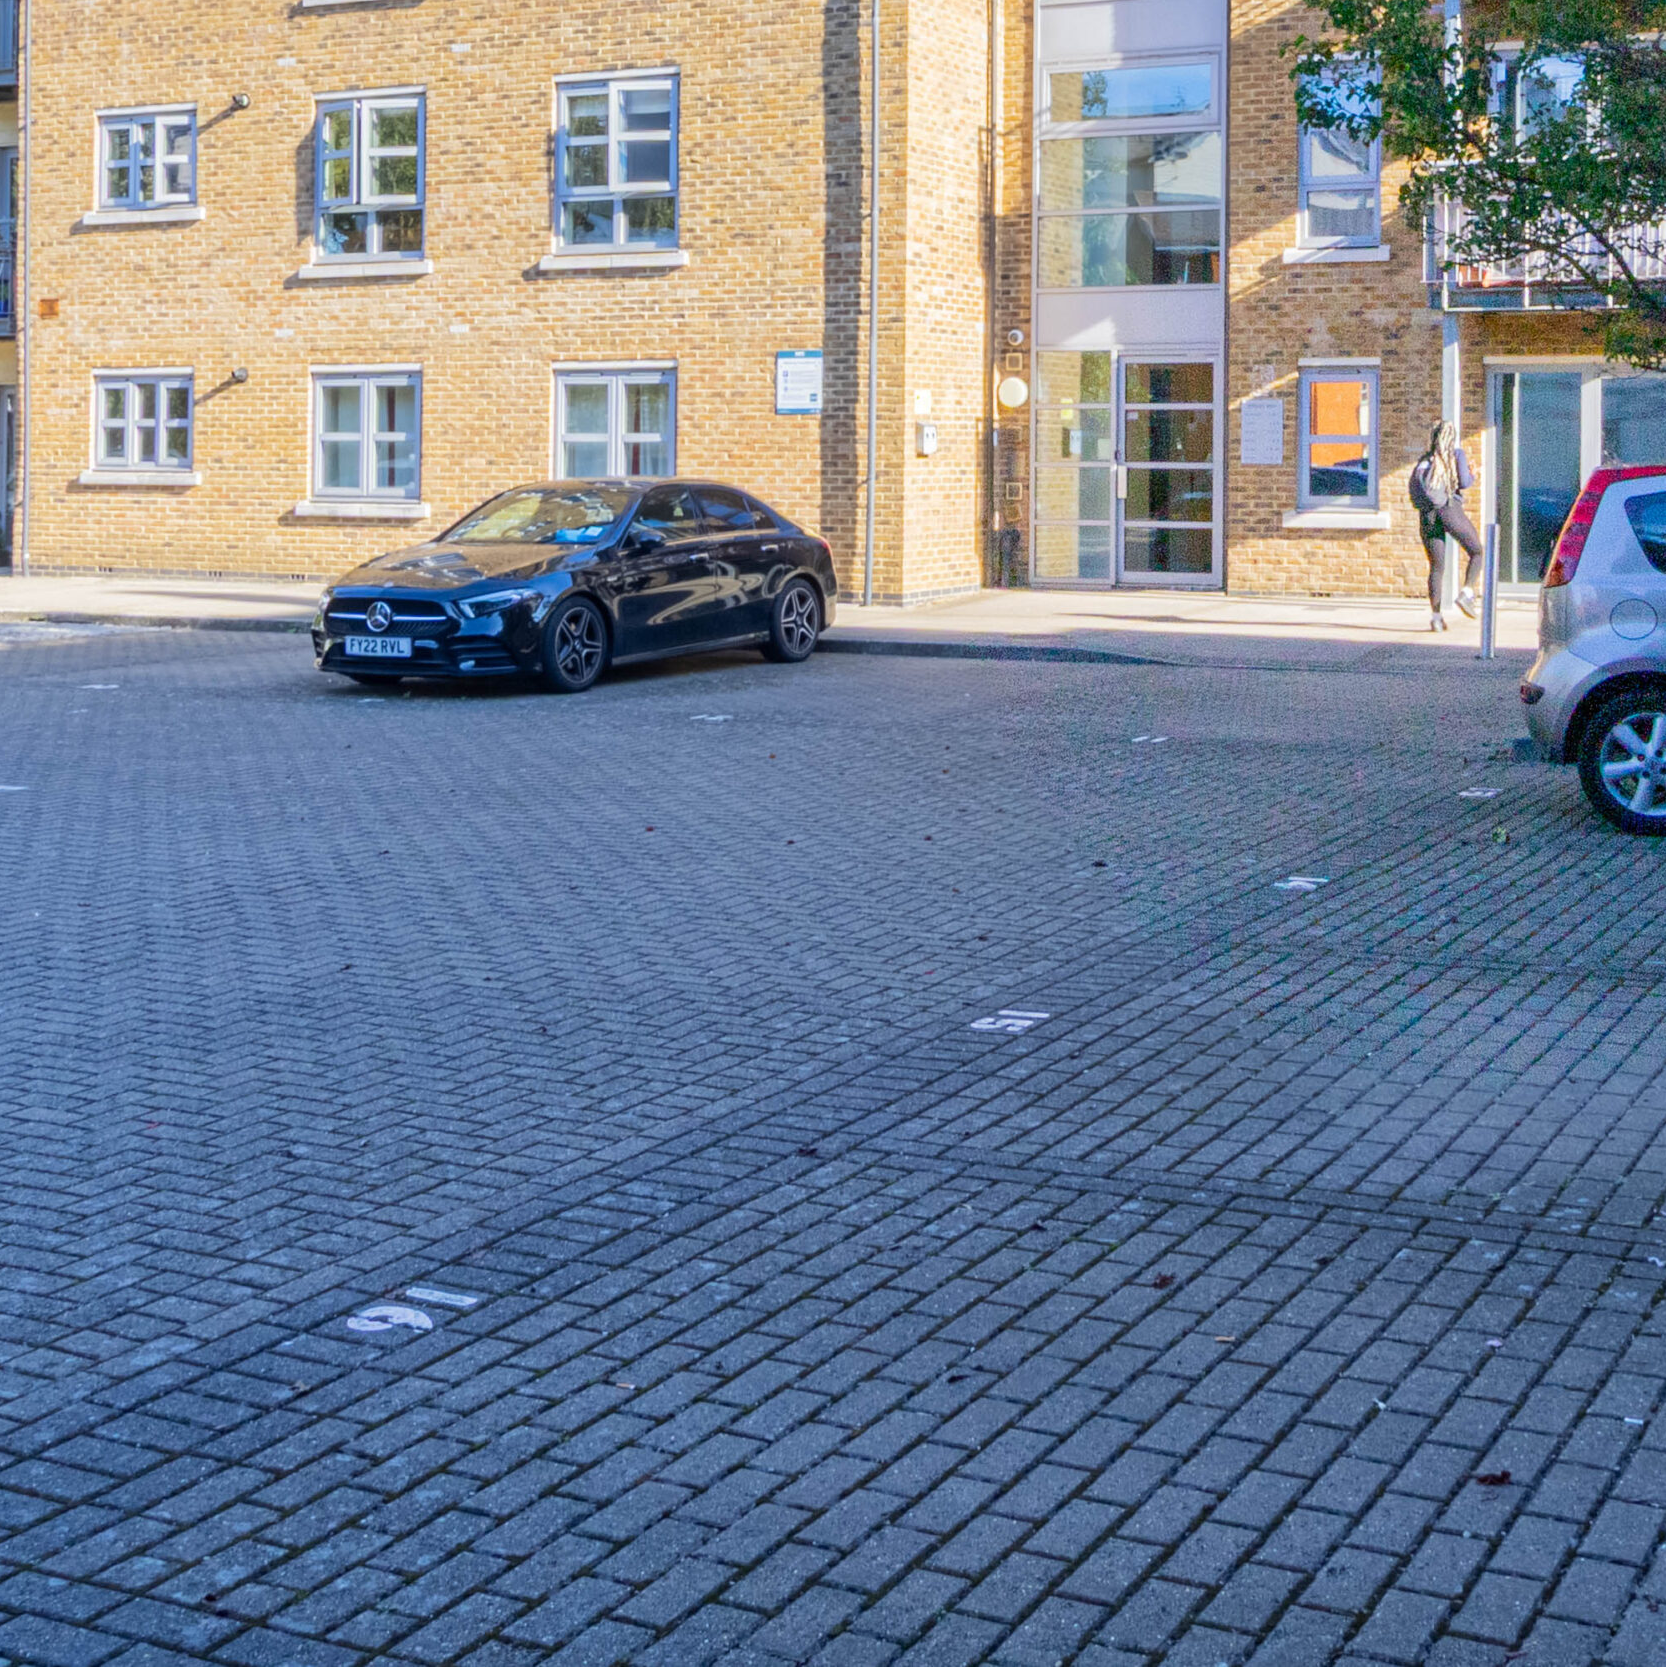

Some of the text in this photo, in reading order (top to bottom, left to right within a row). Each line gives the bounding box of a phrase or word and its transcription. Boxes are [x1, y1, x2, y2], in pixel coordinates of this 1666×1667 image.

[350, 638, 405, 653] FY22 RVL
[970, 1009, 1050, 1031] 15
